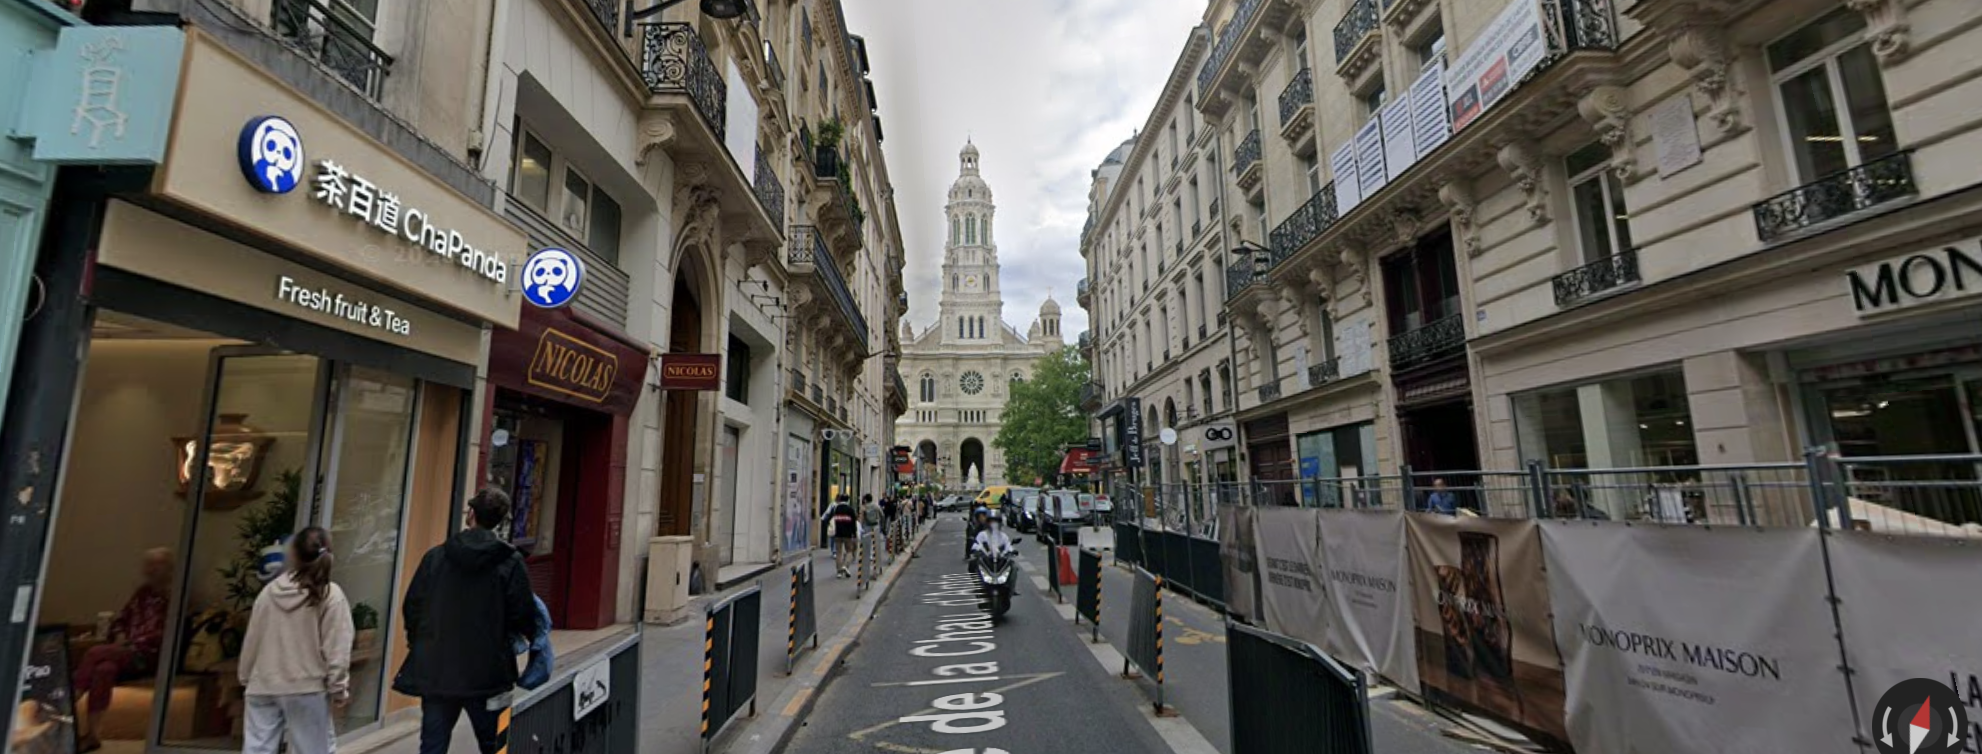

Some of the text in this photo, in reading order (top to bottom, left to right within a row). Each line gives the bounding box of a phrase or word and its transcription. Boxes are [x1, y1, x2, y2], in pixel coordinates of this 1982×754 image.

[316, 159, 506, 283] 茶百道 ChaPanda
[1847, 240, 1982, 311] MON
[278, 276, 410, 335] Fresh fruit & Tea
[535, 341, 613, 392] NICOLAS
[667, 366, 713, 376] NICOLAS
[1681, 642, 1781, 681] MAISON
